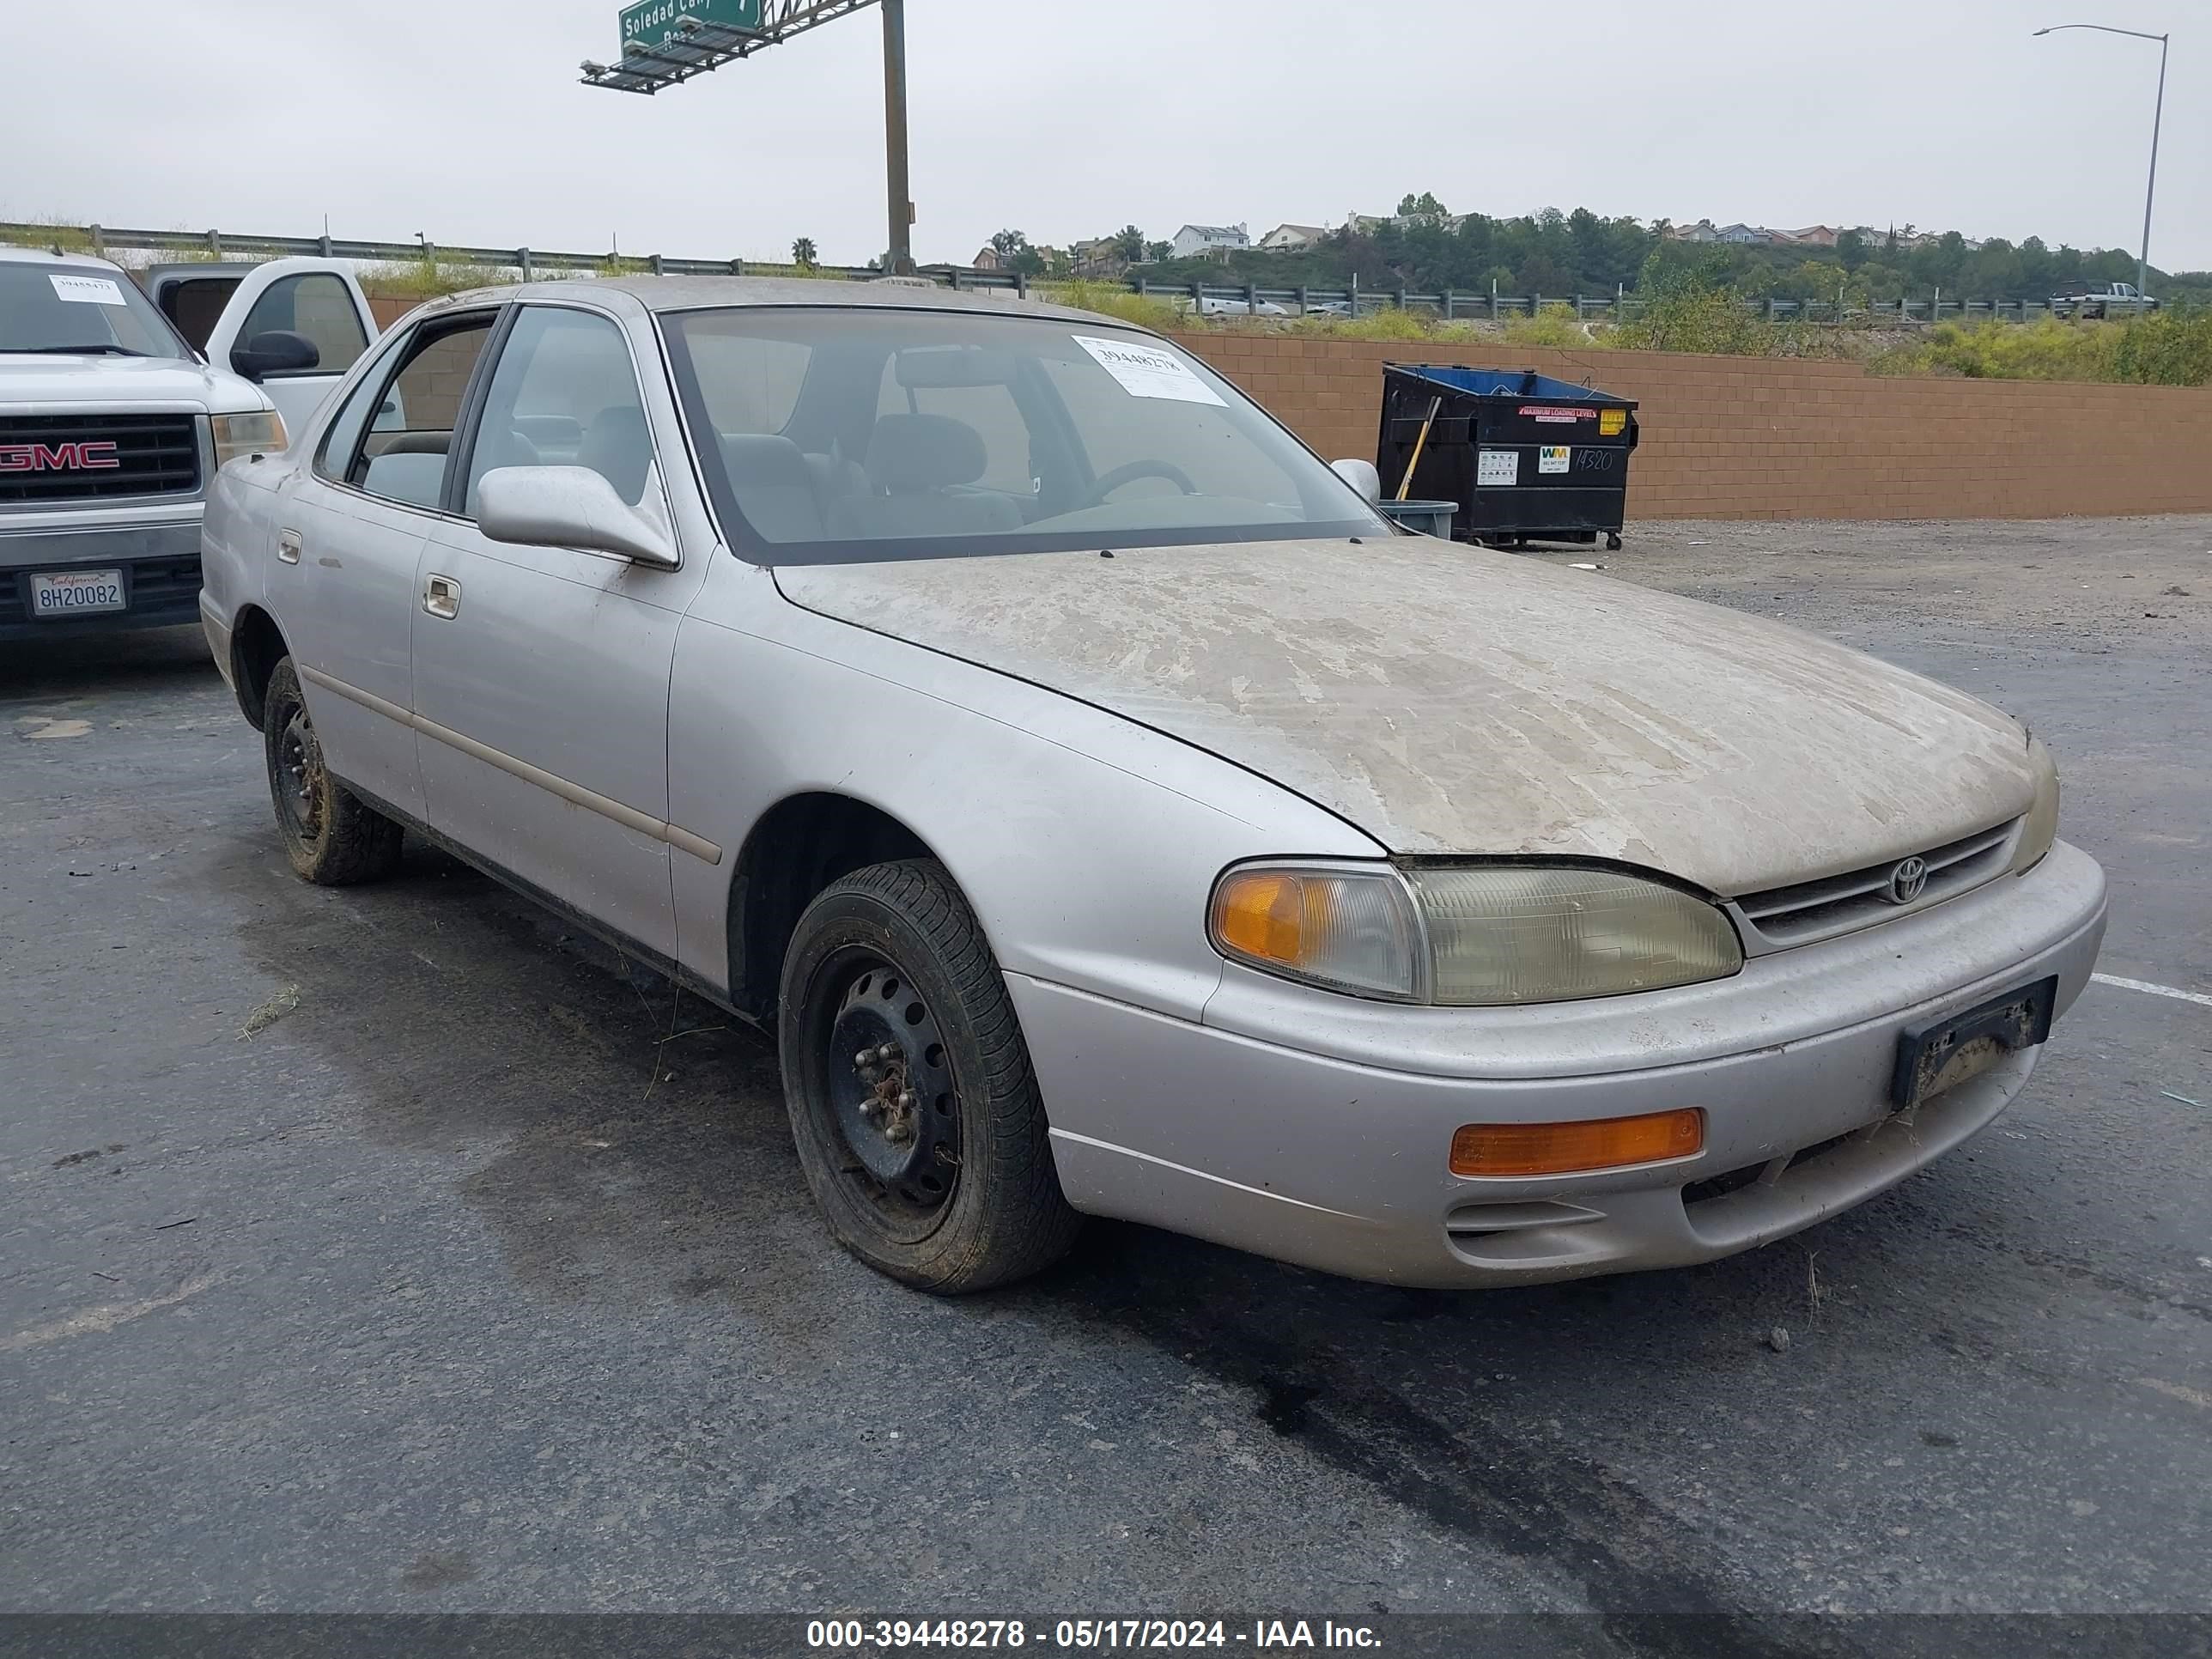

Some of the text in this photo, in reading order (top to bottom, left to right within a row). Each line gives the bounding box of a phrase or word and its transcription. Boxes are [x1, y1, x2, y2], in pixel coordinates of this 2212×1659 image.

[626, 0, 674, 37] Soledad
[1097, 349, 1181, 372] 39448278
[0, 441, 120, 471] GMC
[1542, 447, 1567, 459] WM
[48, 574, 101, 586] California
[40, 585, 118, 607] 8H20082
